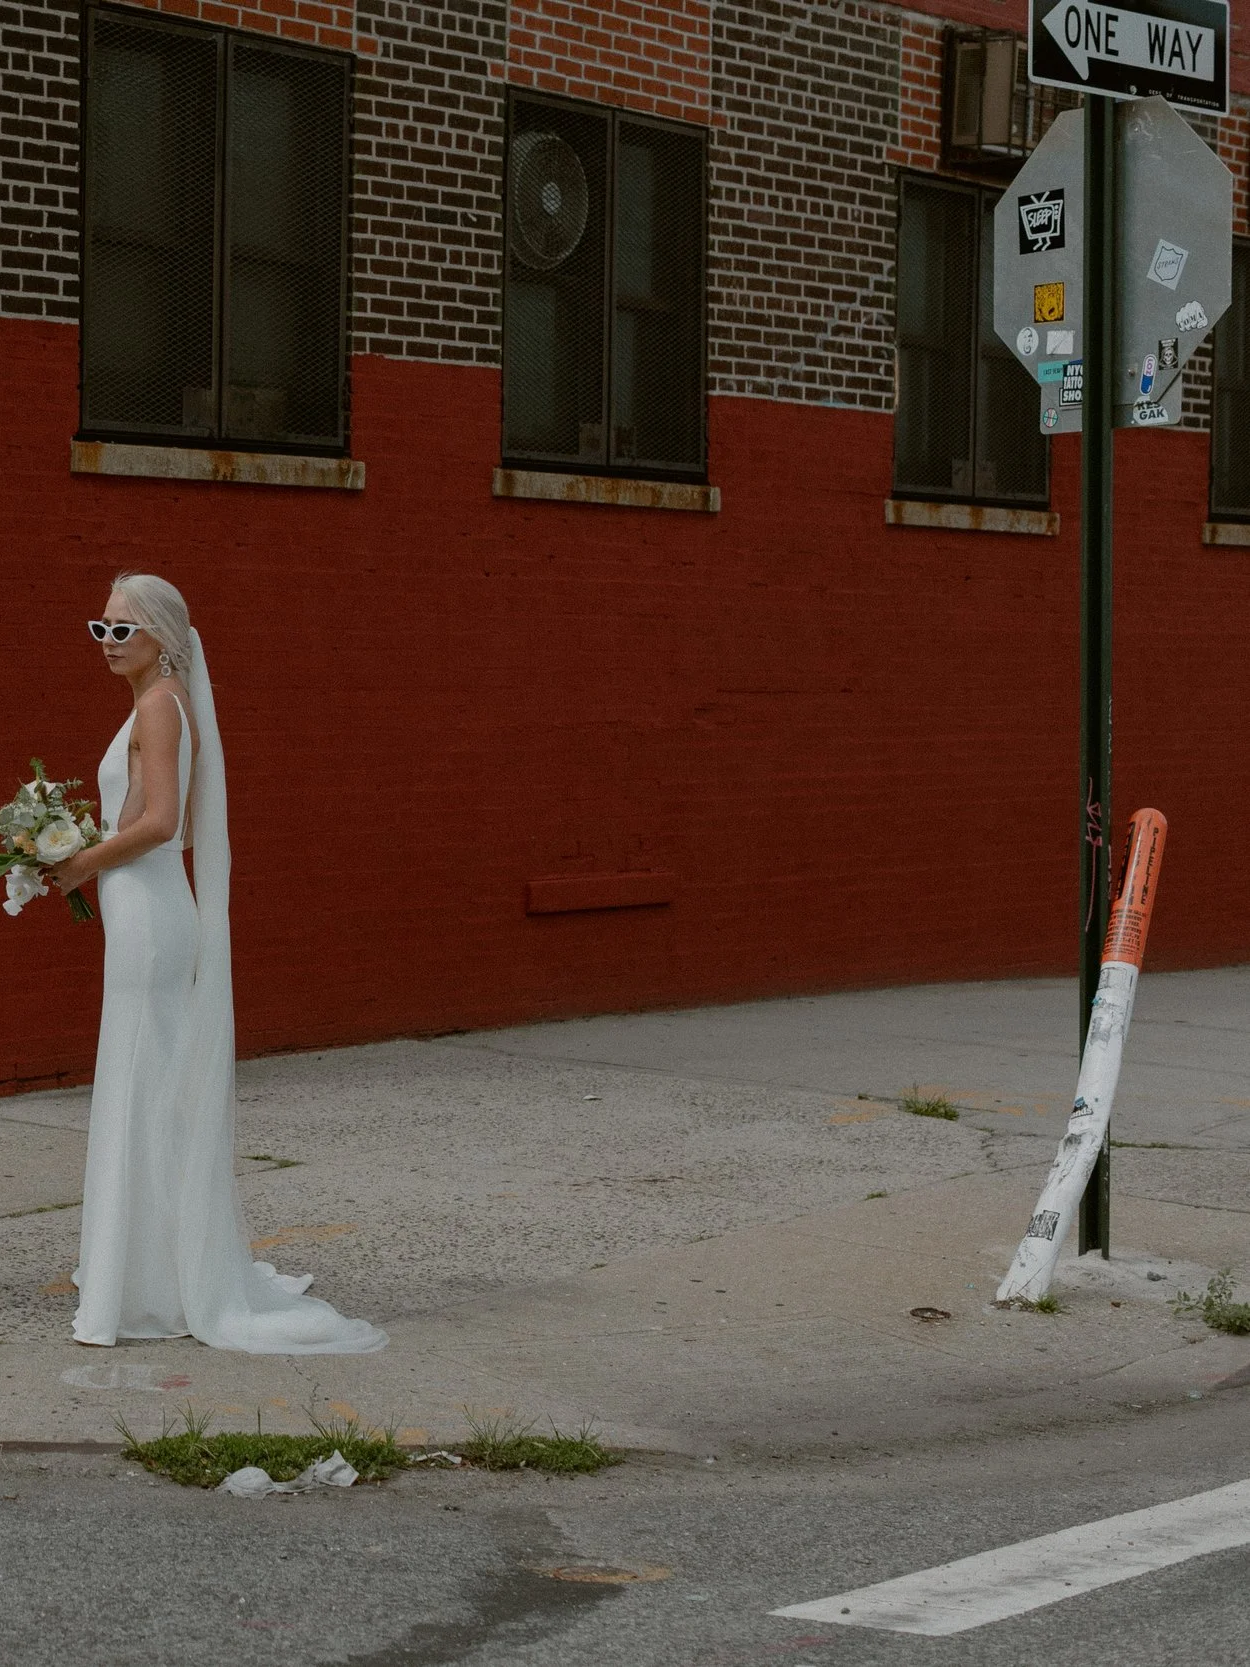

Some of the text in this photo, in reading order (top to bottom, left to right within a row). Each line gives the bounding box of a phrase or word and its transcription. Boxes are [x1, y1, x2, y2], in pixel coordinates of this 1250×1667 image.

[1065, 4, 1203, 72] ONE WAY
[1028, 209, 1052, 227] SLEEP
[1064, 376, 1083, 389] TATTO
[1063, 390, 1083, 402] SHO
[1139, 408, 1165, 420] GAK
[1141, 827, 1159, 904] PIPELINE
